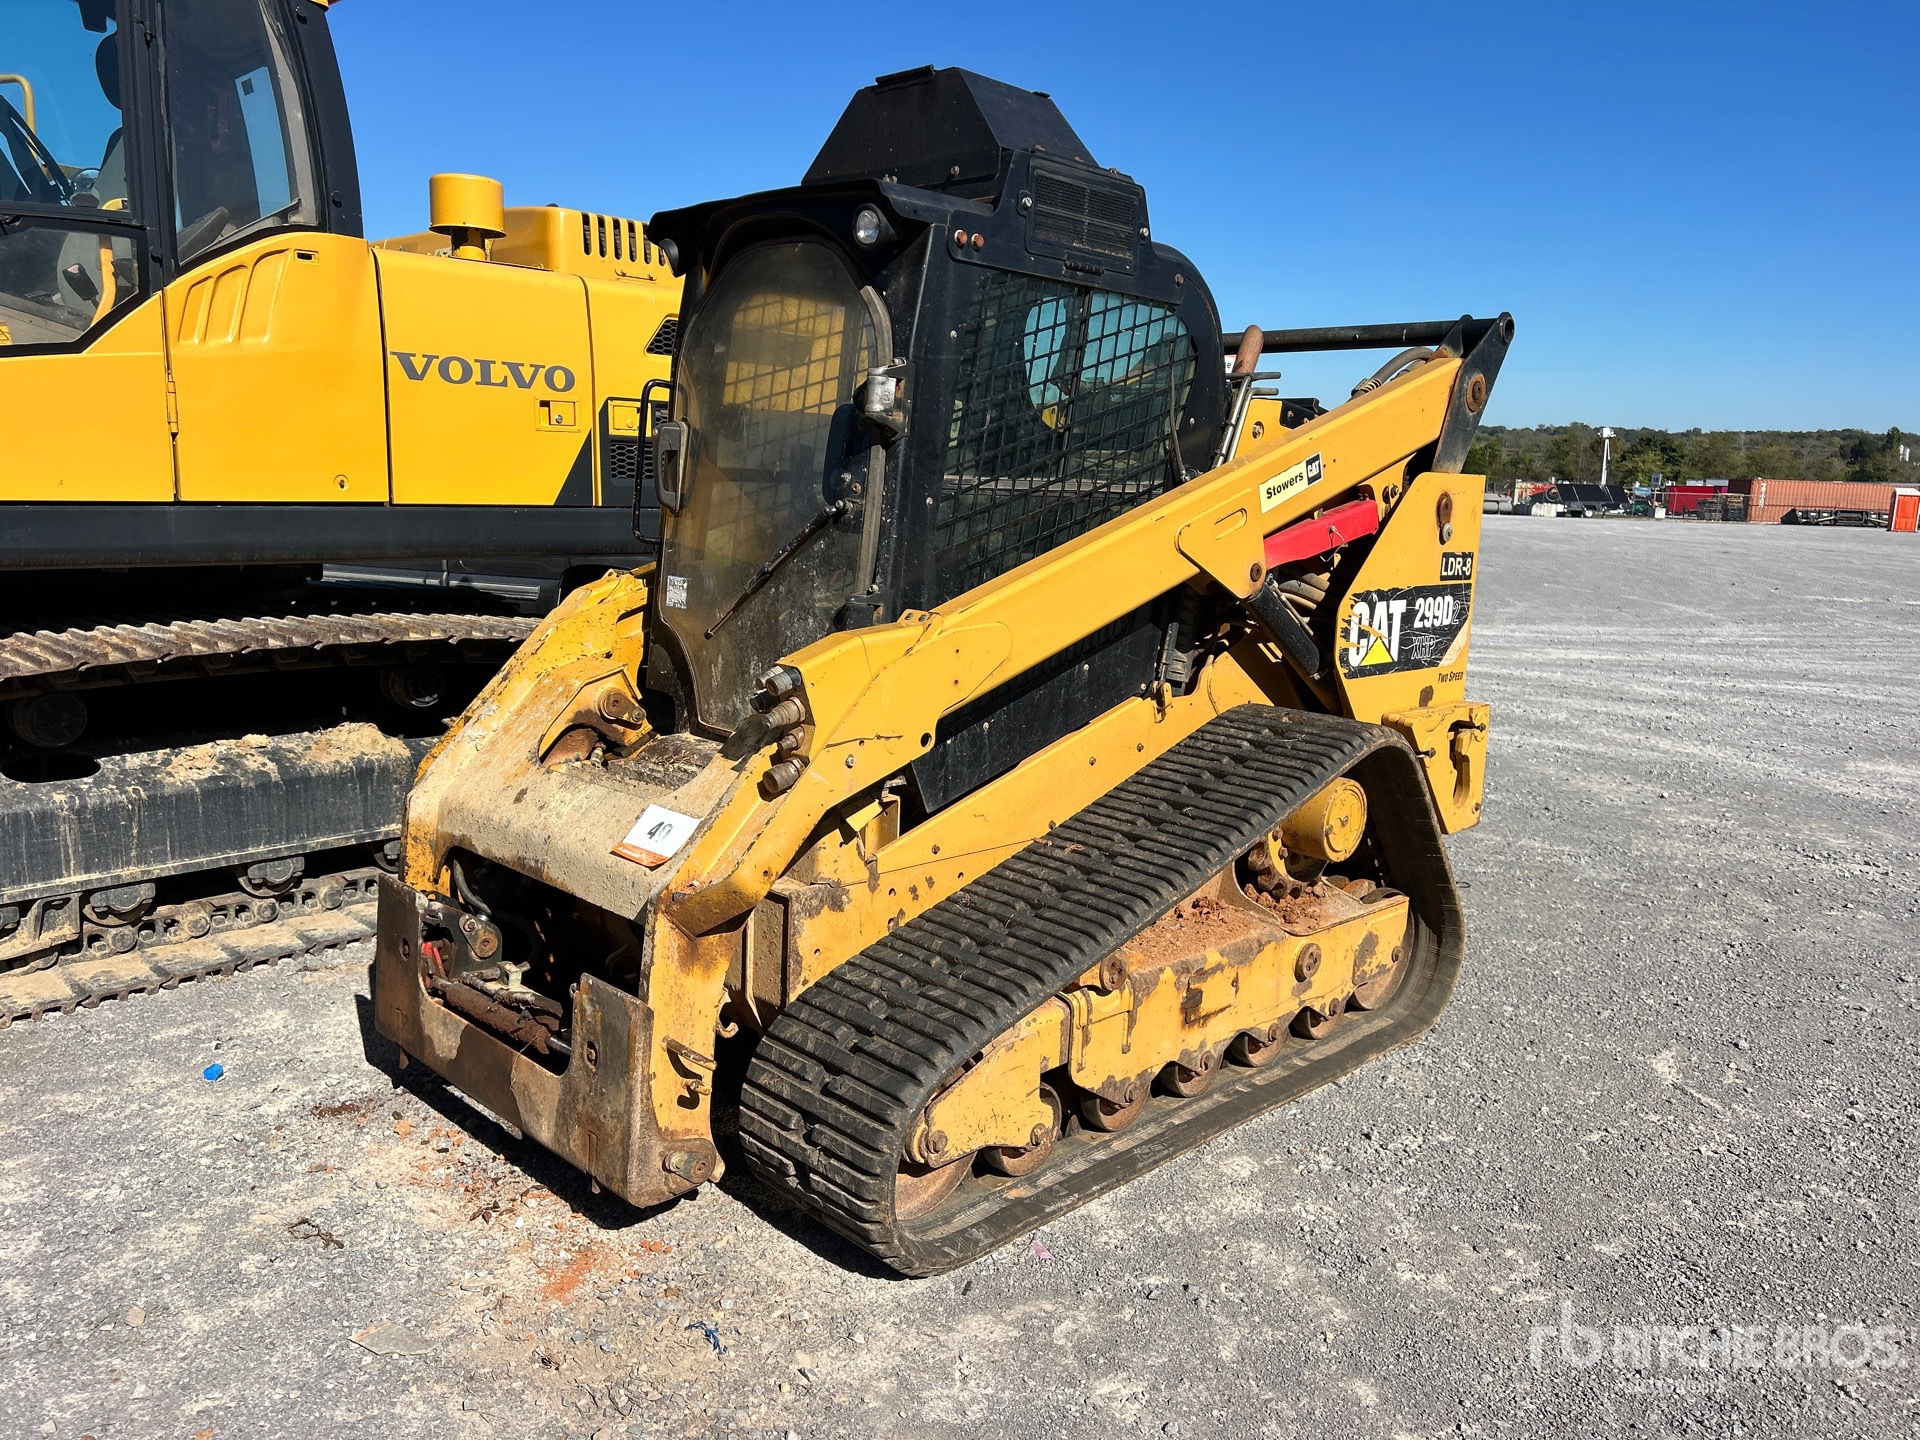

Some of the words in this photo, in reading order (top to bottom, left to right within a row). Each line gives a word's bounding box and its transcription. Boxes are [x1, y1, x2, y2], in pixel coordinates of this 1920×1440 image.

[390, 351, 576, 393] VOLVO
[1266, 472, 1304, 500] Stowers
[1307, 460, 1321, 478] CAT
[1441, 557, 1472, 576] LDR-8
[1348, 599, 1407, 667] CAT
